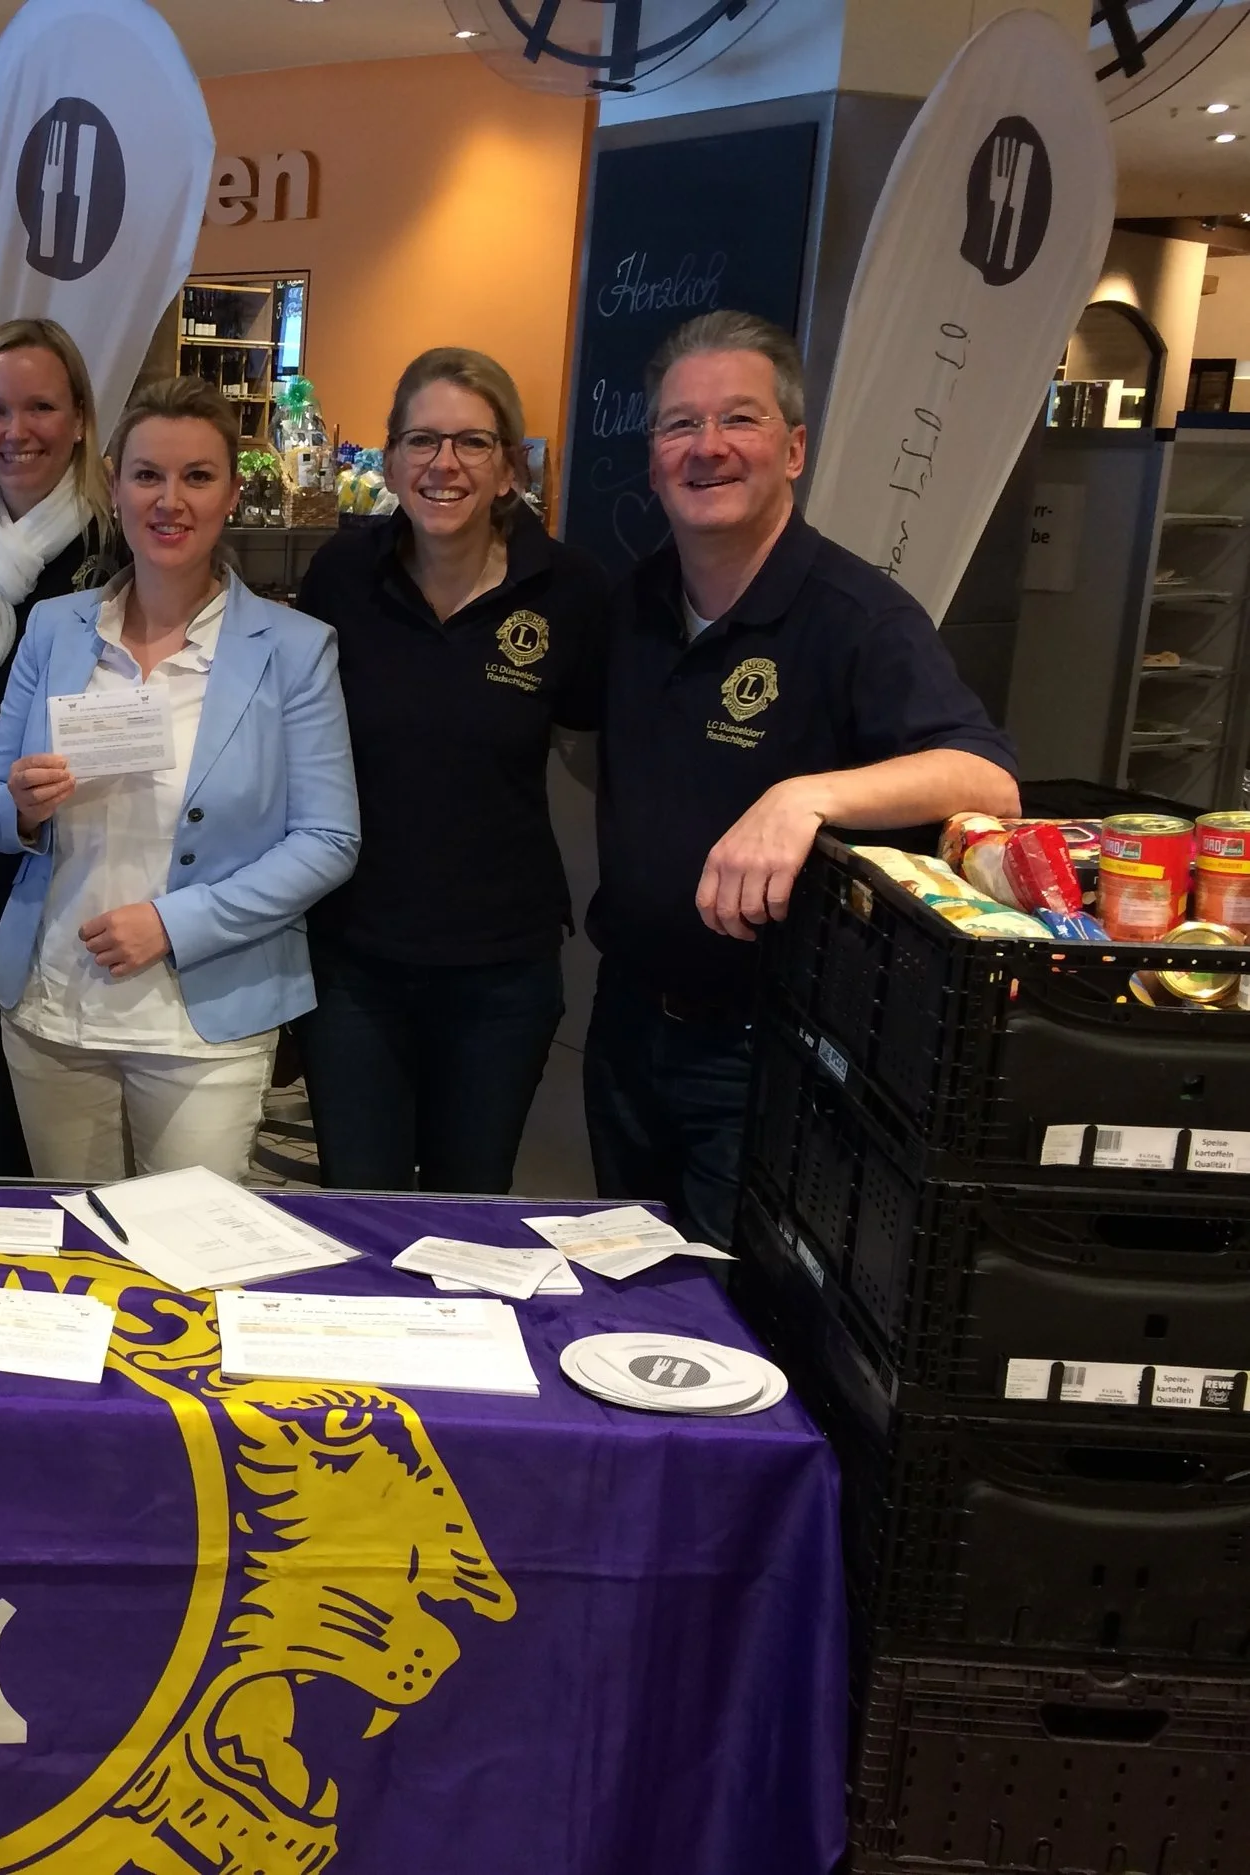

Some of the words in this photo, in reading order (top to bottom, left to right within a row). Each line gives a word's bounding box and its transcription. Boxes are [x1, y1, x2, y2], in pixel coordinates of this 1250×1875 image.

[485, 662, 499, 672] LC
[706, 720, 719, 730] LC
[1195, 1149, 1234, 1158] kartoffeln
[1194, 1160, 1227, 1169] Qualität
[1204, 1379, 1235, 1390] REWE
[1156, 1385, 1194, 1394] kartoffeln
[1156, 1395, 1187, 1404] Qualität
